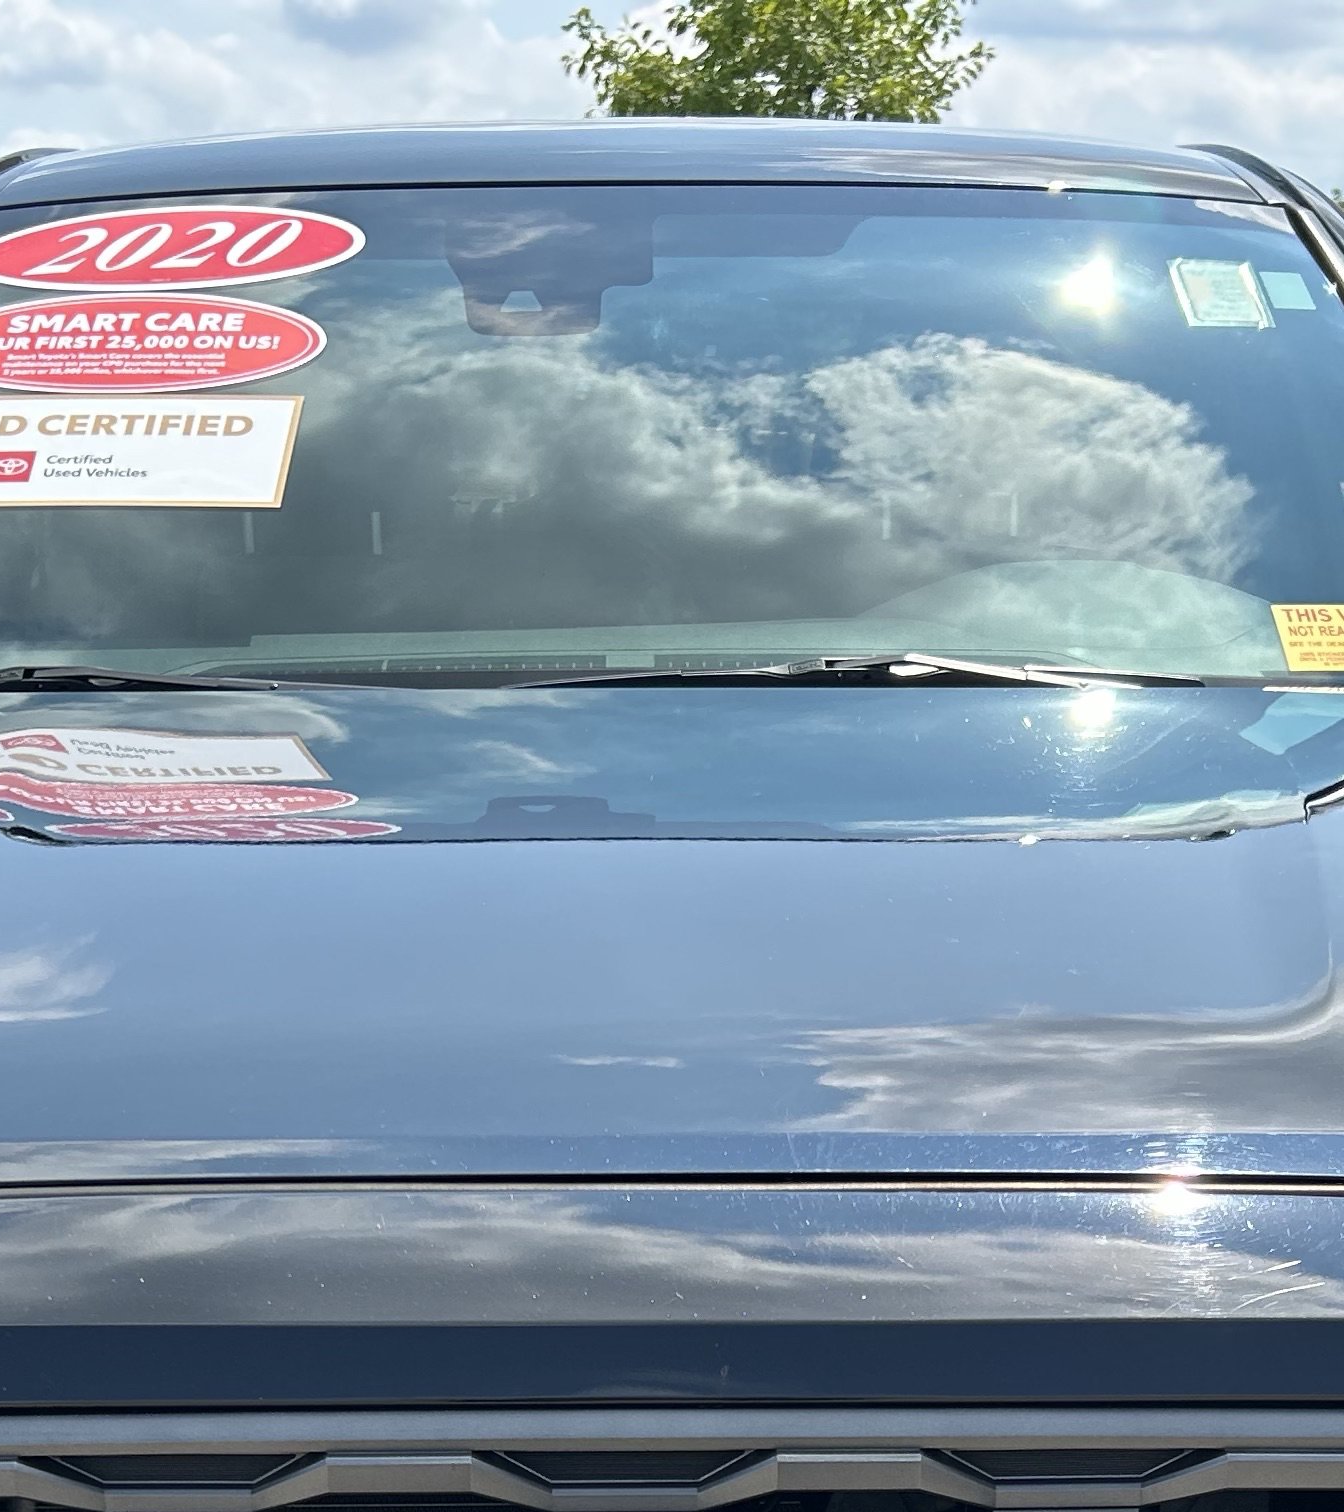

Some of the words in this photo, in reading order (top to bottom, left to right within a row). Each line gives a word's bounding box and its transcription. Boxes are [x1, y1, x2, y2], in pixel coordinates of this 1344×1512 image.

[21, 219, 303, 276] 2020
[7, 313, 142, 334] SMART
[145, 313, 246, 332] CARE
[35, 336, 105, 350] FIRST
[105, 336, 189, 351] 25,000
[193, 336, 235, 350] ON
[238, 335, 281, 350] US!
[37, 414, 254, 437] CERTIFIED
[46, 454, 114, 465] Certified
[43, 468, 83, 478] Used
[86, 467, 148, 478] Vehicles
[1282, 609, 1332, 622] THIS
[1288, 626, 1315, 637] NOT
